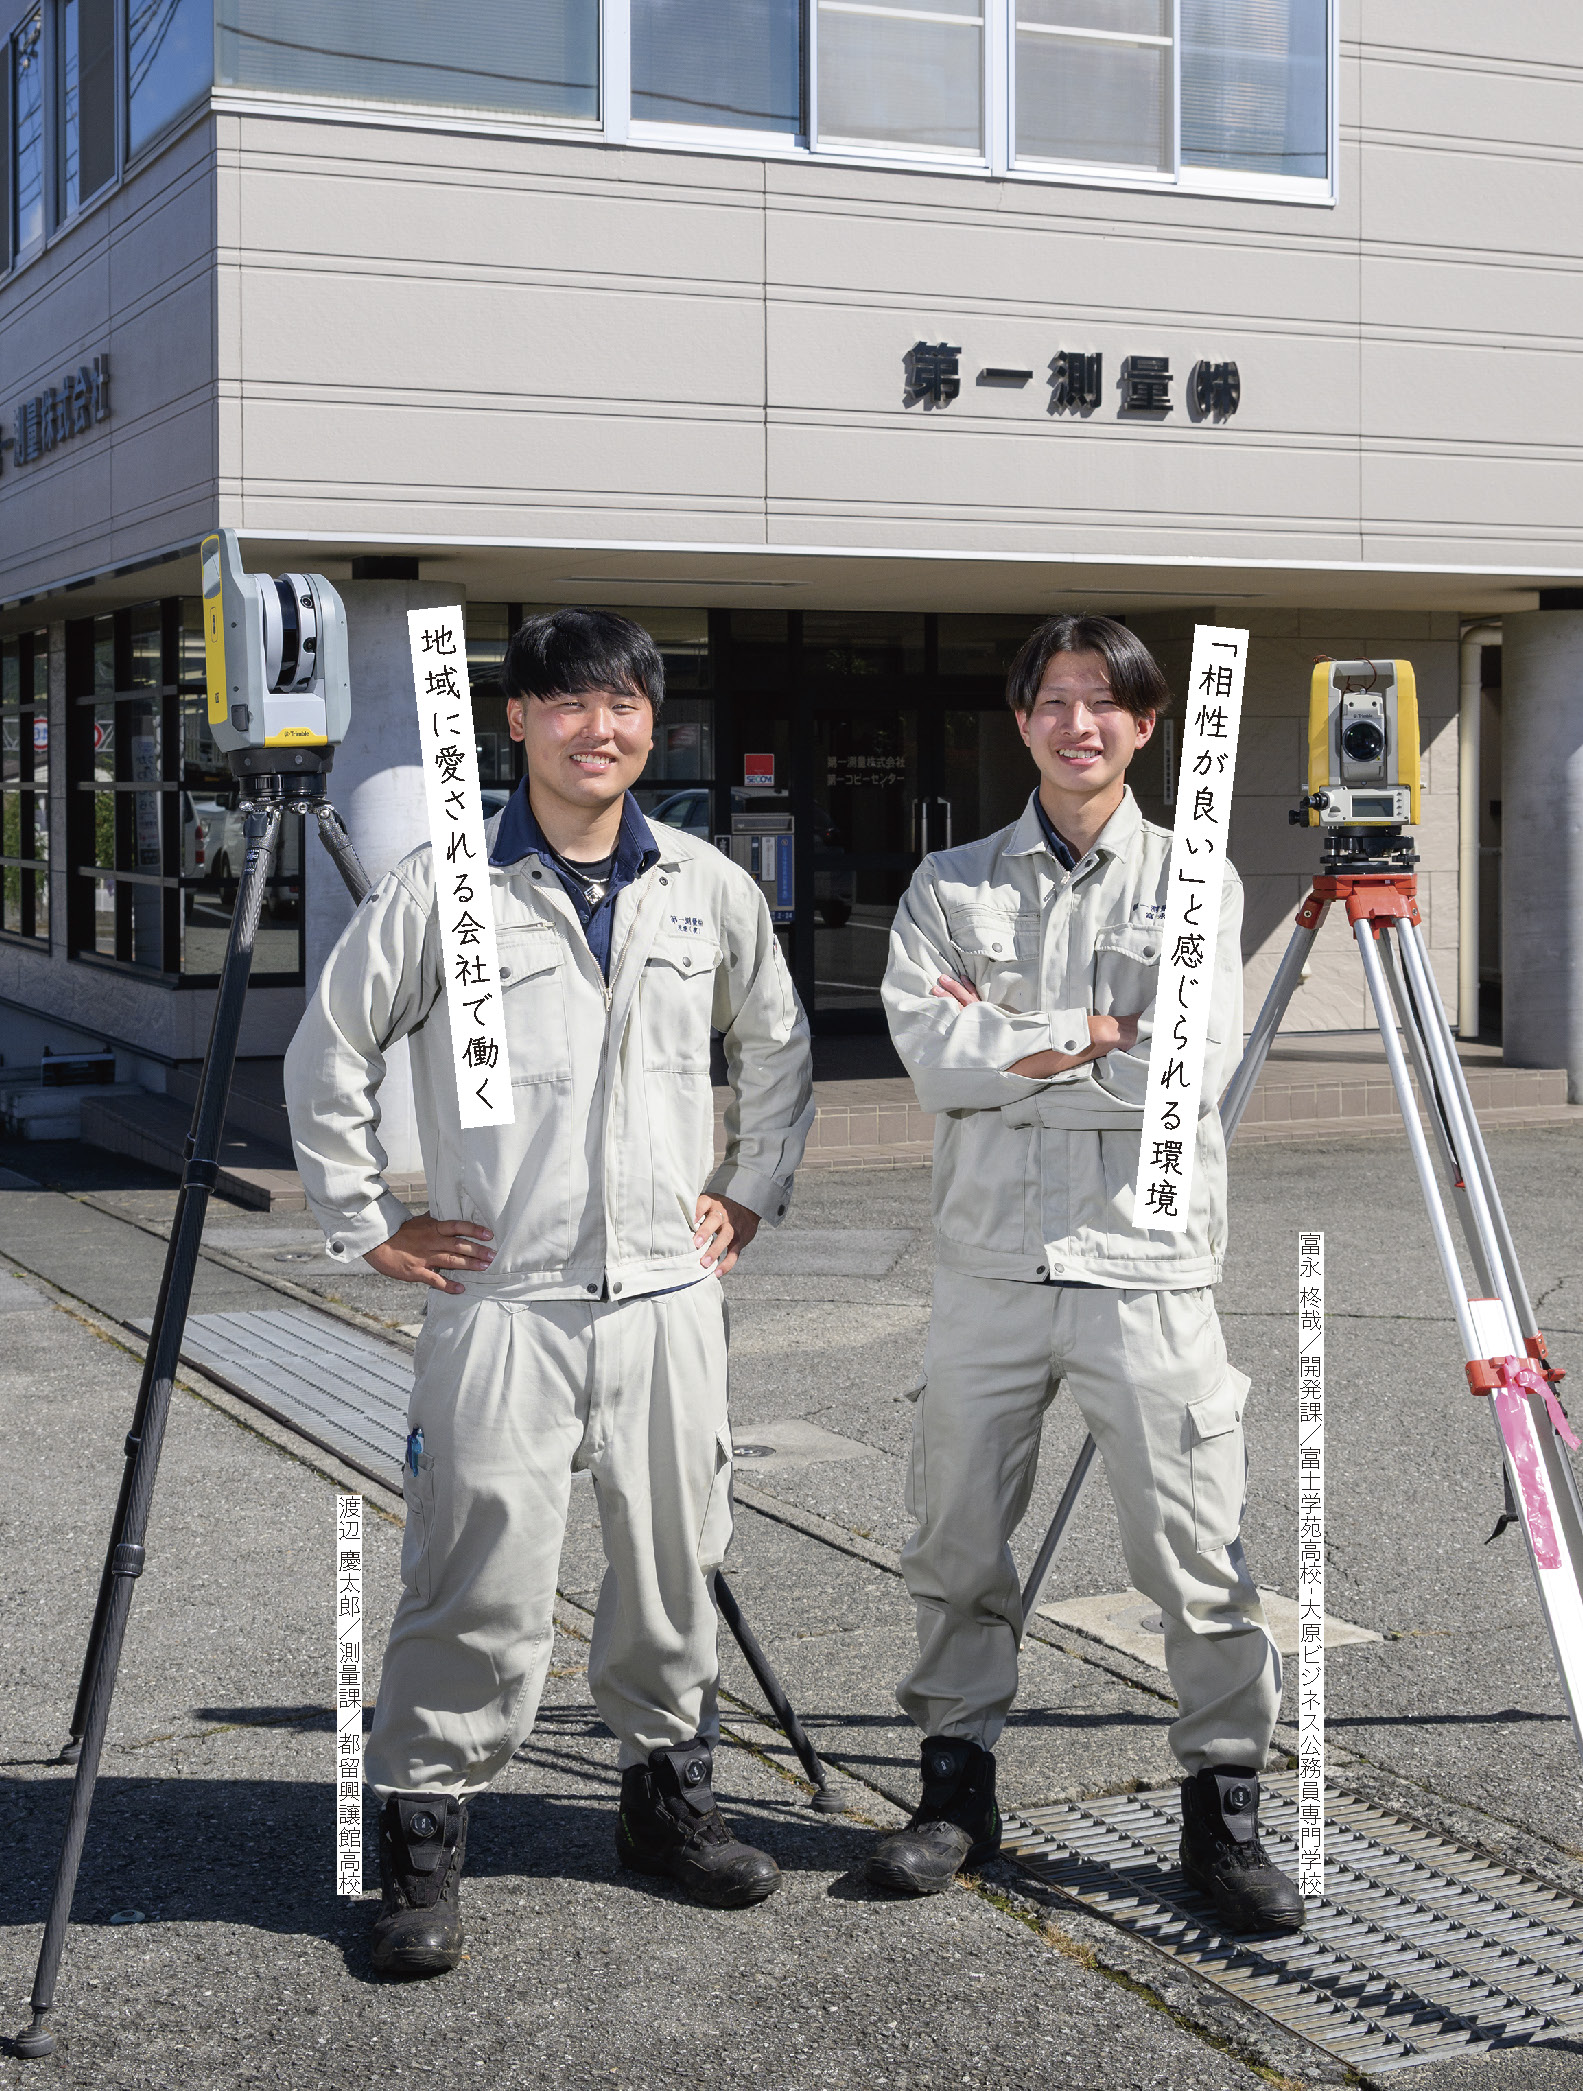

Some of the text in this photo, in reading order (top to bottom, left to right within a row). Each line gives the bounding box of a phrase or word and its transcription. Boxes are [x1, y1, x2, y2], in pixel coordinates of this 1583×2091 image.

[0, 352, 110, 476] 一測量株式会社
